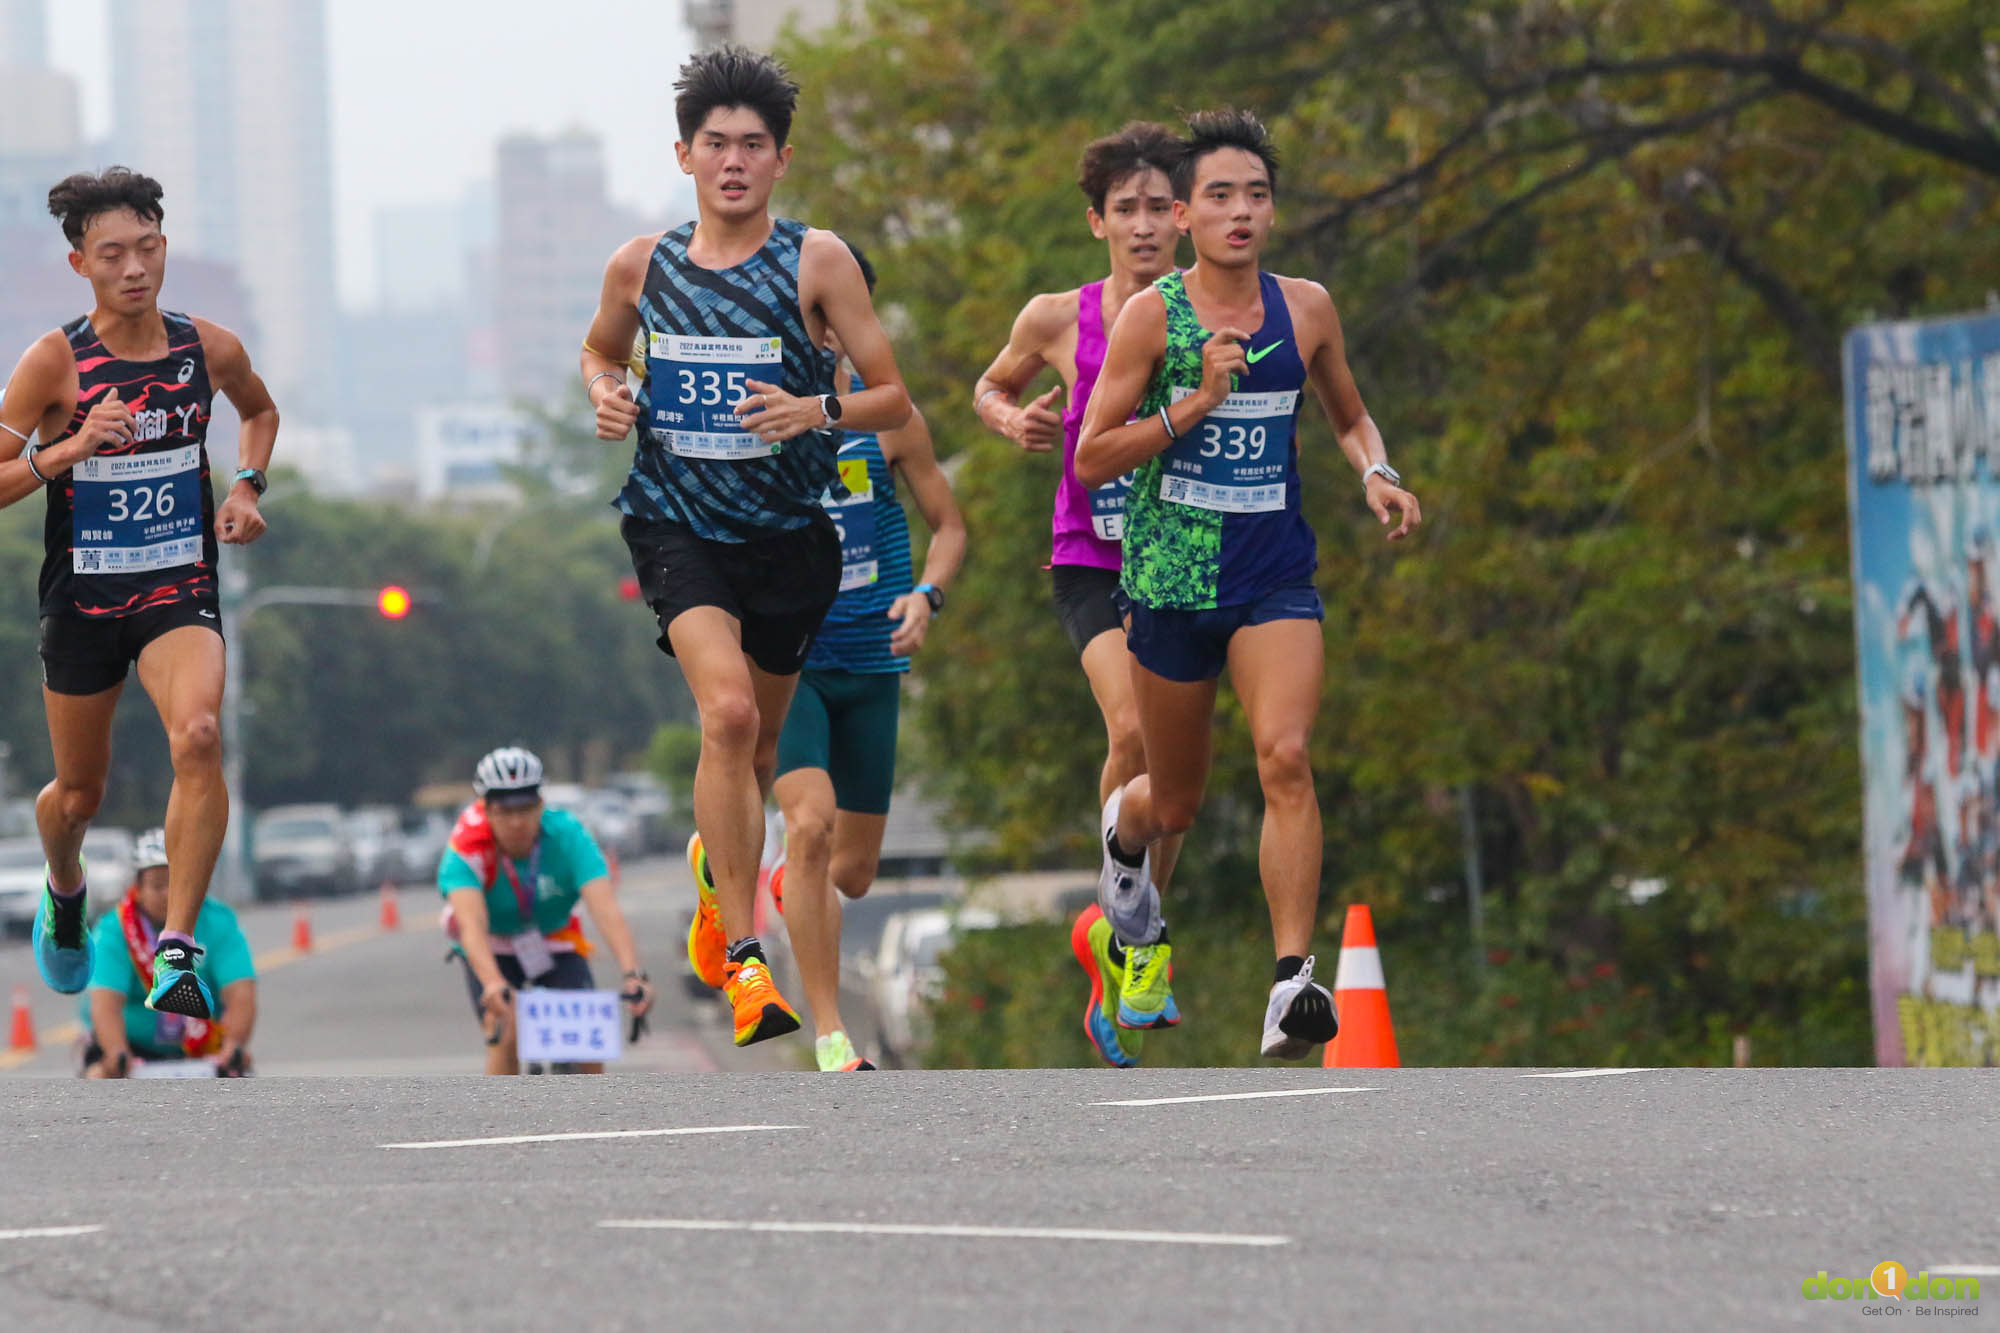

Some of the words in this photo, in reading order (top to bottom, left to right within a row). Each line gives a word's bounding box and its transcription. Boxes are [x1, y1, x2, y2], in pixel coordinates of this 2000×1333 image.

[678, 369, 748, 406] 335
[1200, 424, 1267, 460] 339
[108, 482, 175, 522] 326
[1103, 517, 1117, 537] E
